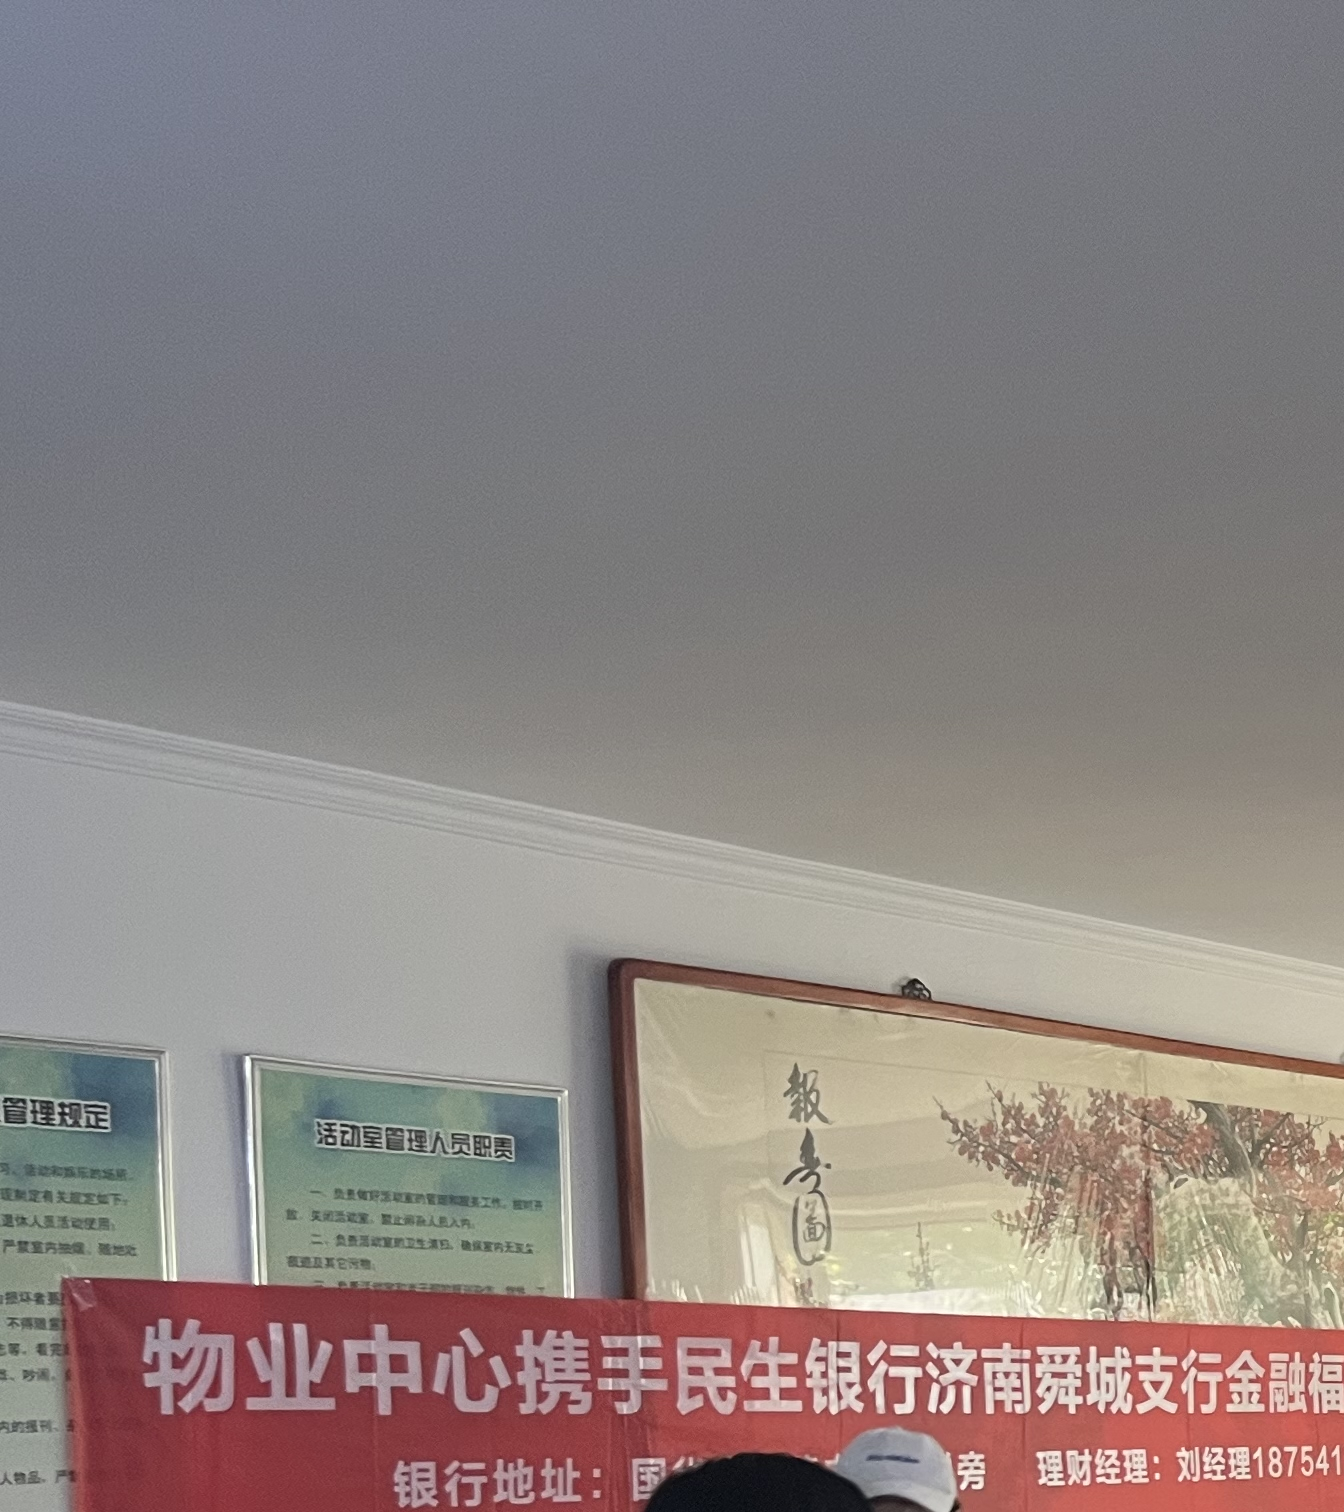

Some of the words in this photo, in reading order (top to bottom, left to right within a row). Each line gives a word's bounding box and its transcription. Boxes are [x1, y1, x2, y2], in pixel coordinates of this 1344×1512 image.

[0, 1096, 110, 1130] 管理规定
[316, 1120, 514, 1161] 活动室管理人员职责
